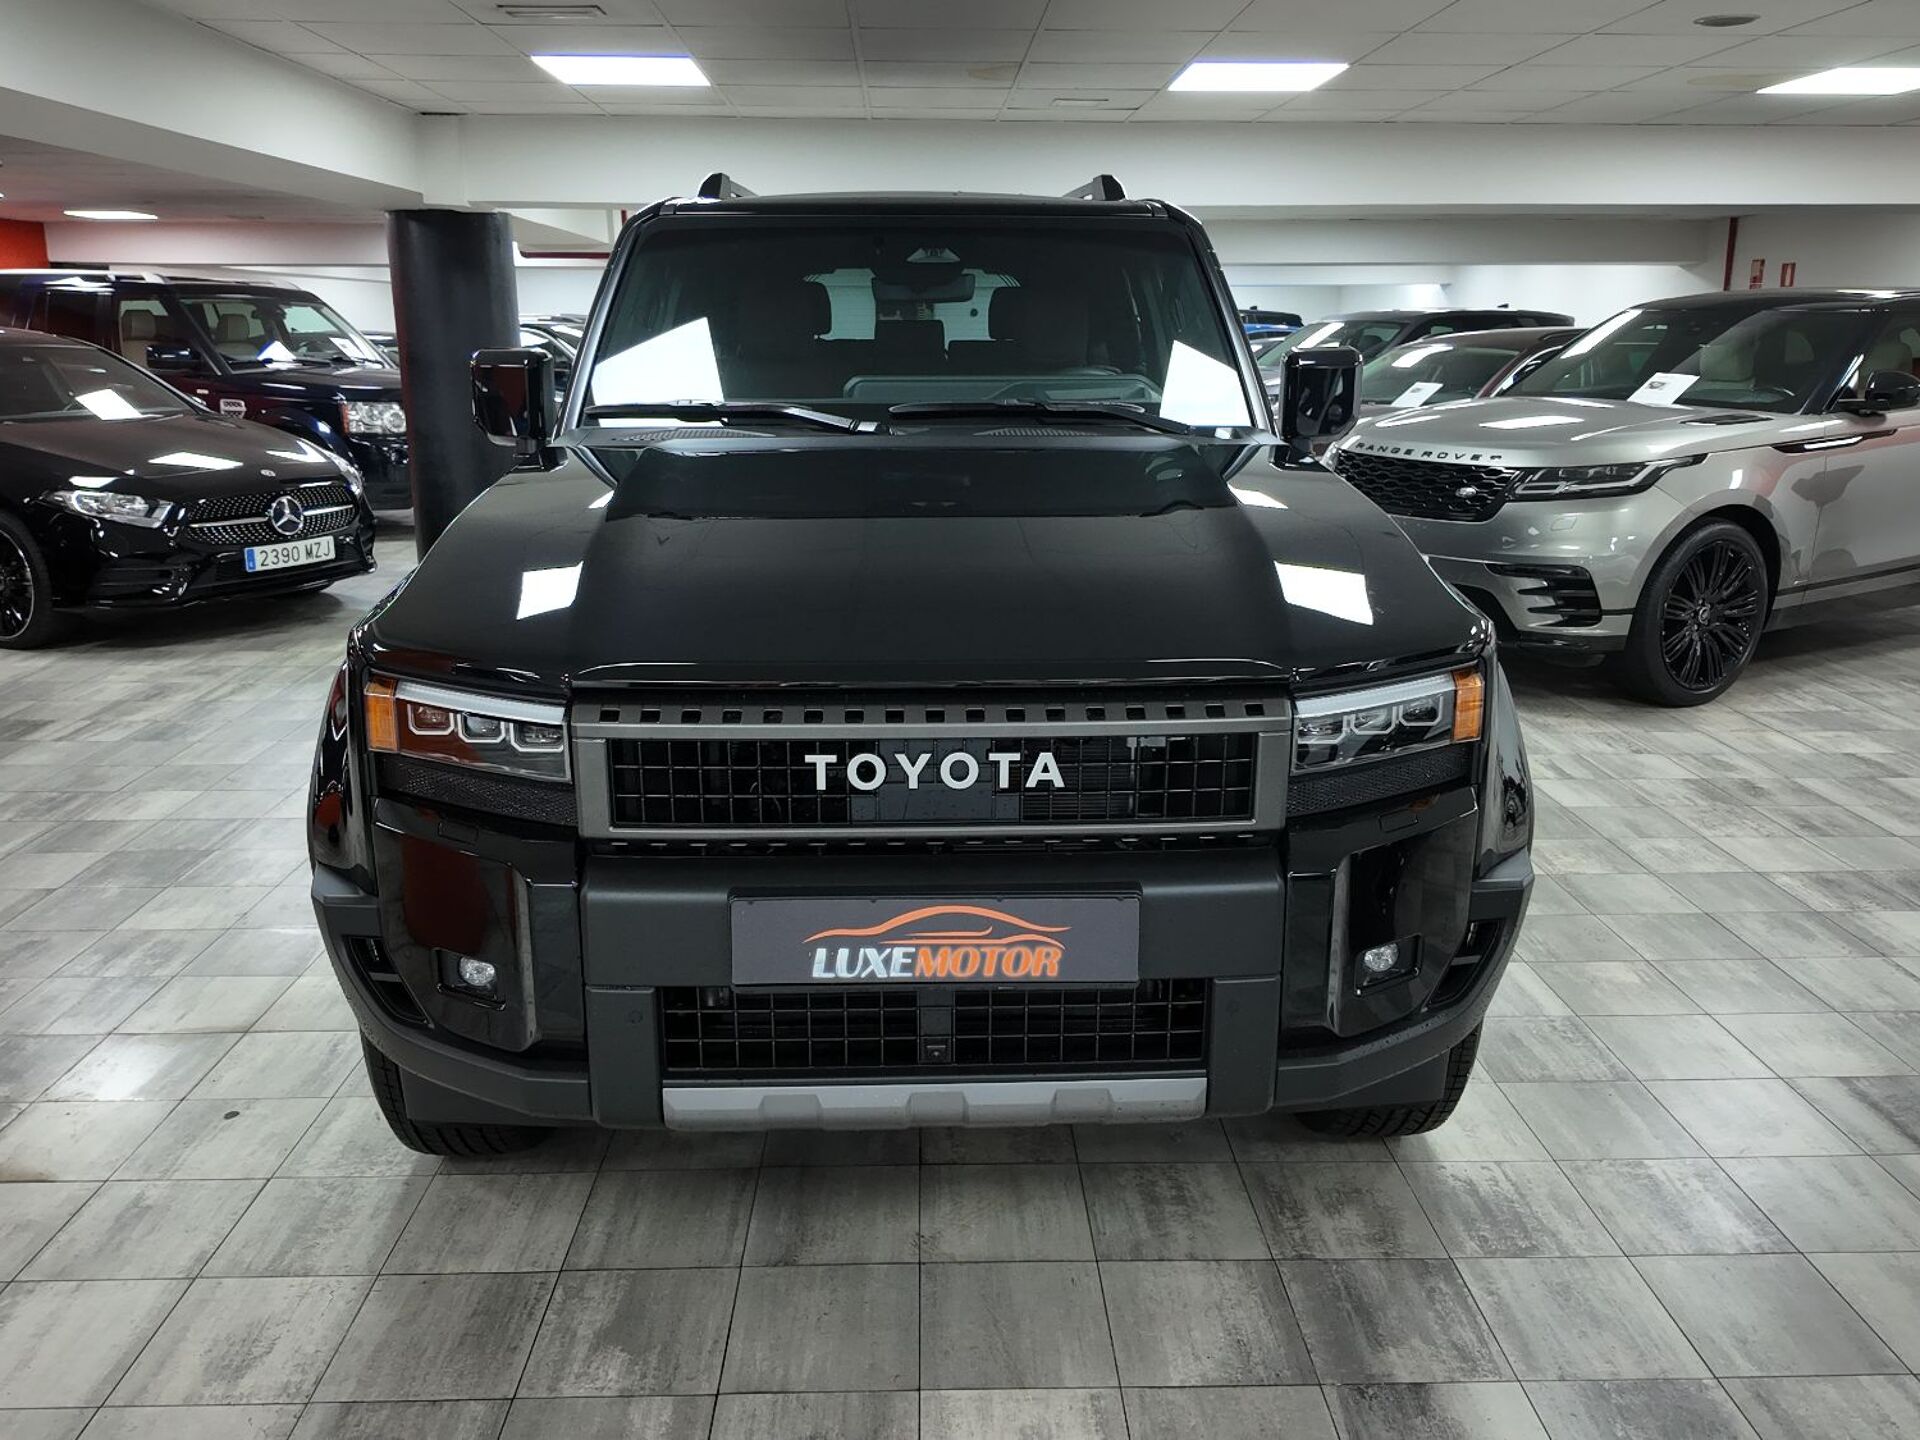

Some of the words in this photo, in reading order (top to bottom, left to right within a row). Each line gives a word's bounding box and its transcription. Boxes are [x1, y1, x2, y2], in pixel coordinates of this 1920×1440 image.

[1355, 442, 1415, 456] RANGE
[259, 546, 301, 567] 2390
[305, 540, 331, 560] MZJ
[804, 752, 1066, 791] TOYOTA
[811, 946, 1063, 979] LUXEMOTOR
